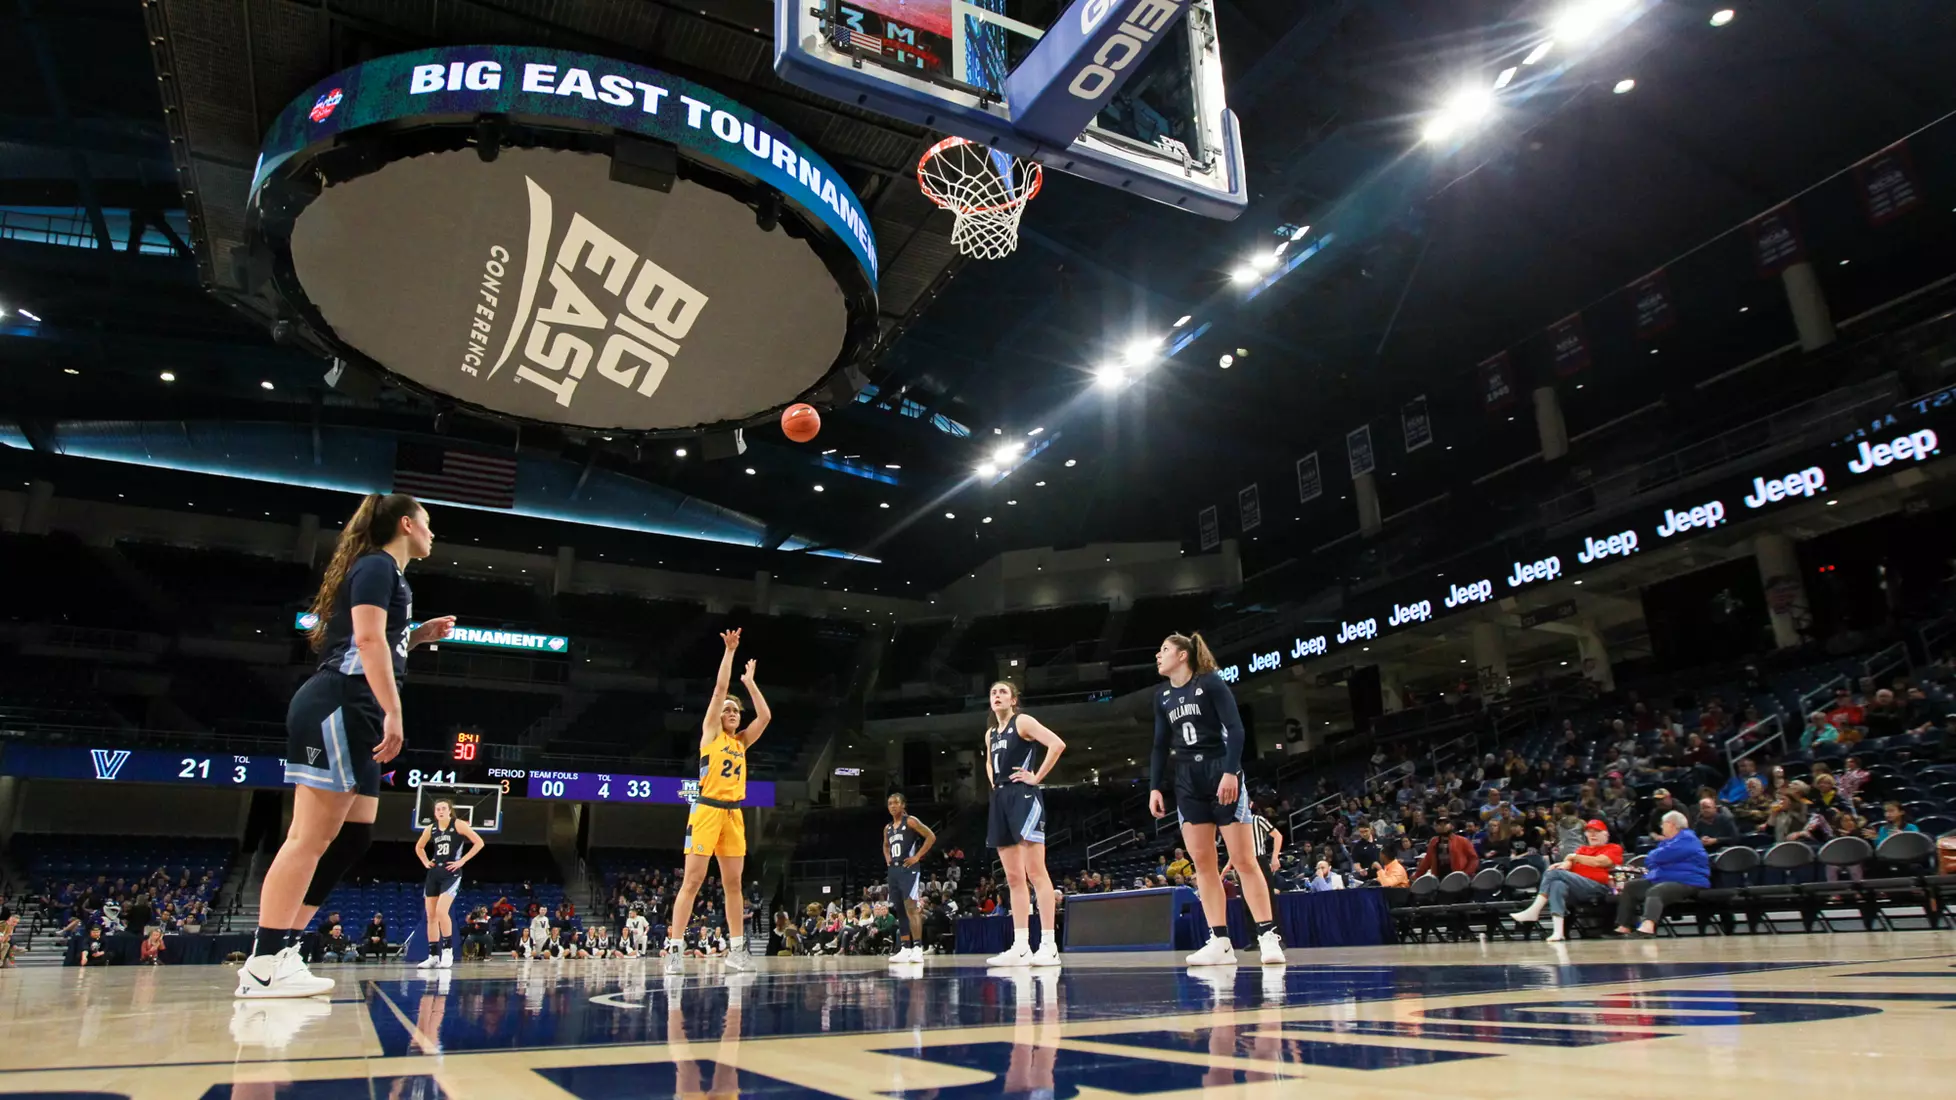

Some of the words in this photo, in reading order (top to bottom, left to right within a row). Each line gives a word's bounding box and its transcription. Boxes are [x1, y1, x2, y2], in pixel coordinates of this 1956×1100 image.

[1068, 0, 1180, 100] EICO
[410, 61, 502, 94] BIG
[522, 63, 668, 115] EAST
[461, 245, 510, 377] CONFERENCE
[524, 212, 639, 407] EAST
[597, 259, 709, 397] BIG
[1218, 665, 1239, 682] eep
[1249, 651, 1280, 673] Jeep
[1291, 635, 1326, 658] Jeep
[1337, 618, 1377, 644] Jeep
[1389, 600, 1431, 626] Jeep
[1445, 579, 1492, 608] Jeep
[1508, 556, 1561, 587] Jeep
[1578, 530, 1637, 564] Jeep
[1657, 500, 1725, 537] Jeep
[1744, 466, 1826, 508] Jeep
[1848, 429, 1938, 474] Jeep
[1168, 703, 1202, 723] VILLANOVA
[458, 732, 480, 743] 8:41
[1182, 721, 1198, 746] 0
[233, 755, 250, 764] TOL
[453, 743, 476, 760] 30
[178, 758, 211, 778] 21
[232, 765, 247, 783] 3
[488, 768, 525, 779] PERIOD
[529, 770, 552, 779] TEAM
[552, 771, 579, 780] FOULS
[720, 759, 742, 781] 24
[407, 769, 456, 787] 8:41
[500, 779, 511, 794] 3
[597, 774, 612, 782] TOL
[541, 780, 565, 797] 00
[597, 782, 610, 799] 4
[626, 779, 651, 798] 33
[891, 843, 902, 858] 10
